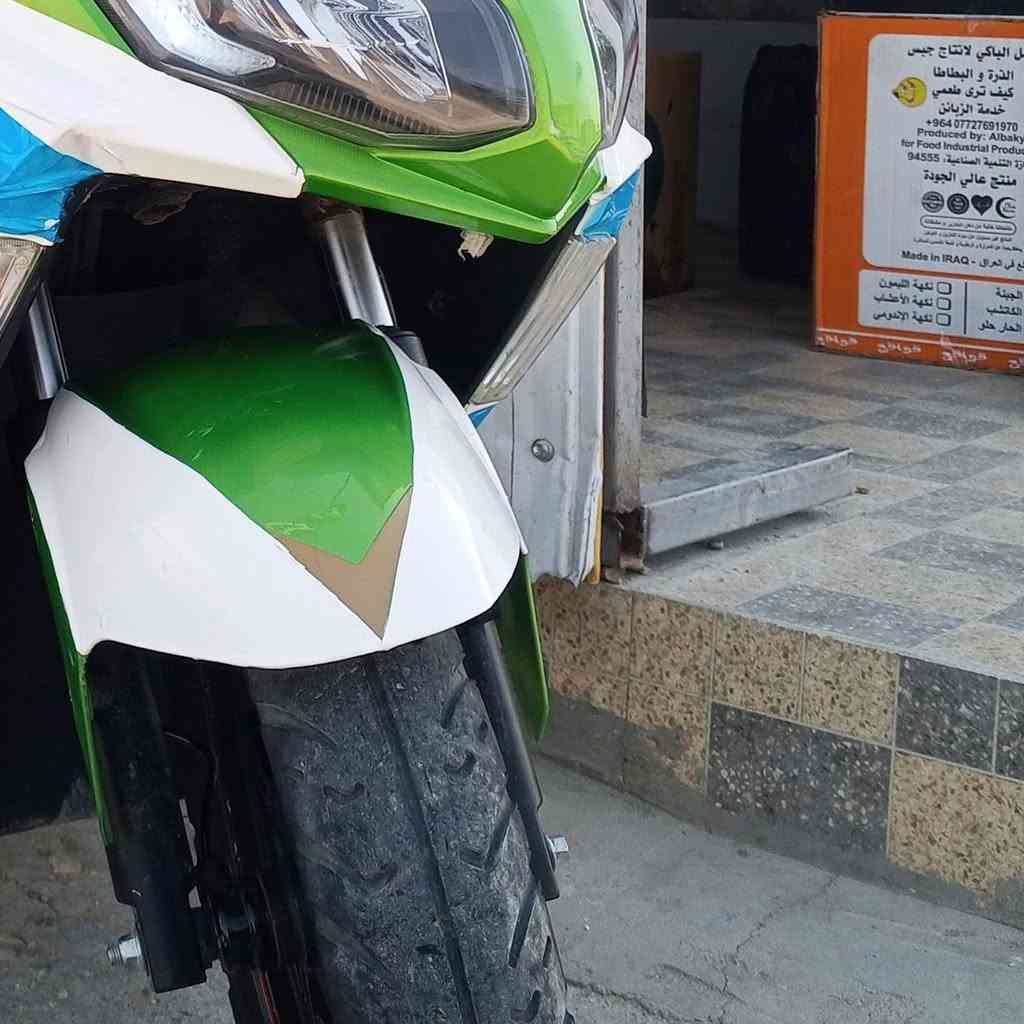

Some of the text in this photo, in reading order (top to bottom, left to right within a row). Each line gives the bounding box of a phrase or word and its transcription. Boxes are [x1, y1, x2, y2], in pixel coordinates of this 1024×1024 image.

[933, 66, 1014, 83] الذرة و البطاطا
[931, 84, 1014, 100] كيف ترى طعمي
[977, 102, 1006, 115] خدمة
[925, 118, 1018, 132] +964 07727691970
[917, 128, 1024, 145] Produced by: Albaky
[901, 138, 915, 147] for
[917, 139, 942, 150] Food
[943, 141, 989, 154] Industrial
[907, 151, 940, 163] 94555
[923, 169, 1017, 189] منتج عالي الجودة
[901, 250, 970, 265] Made in IRAQ
